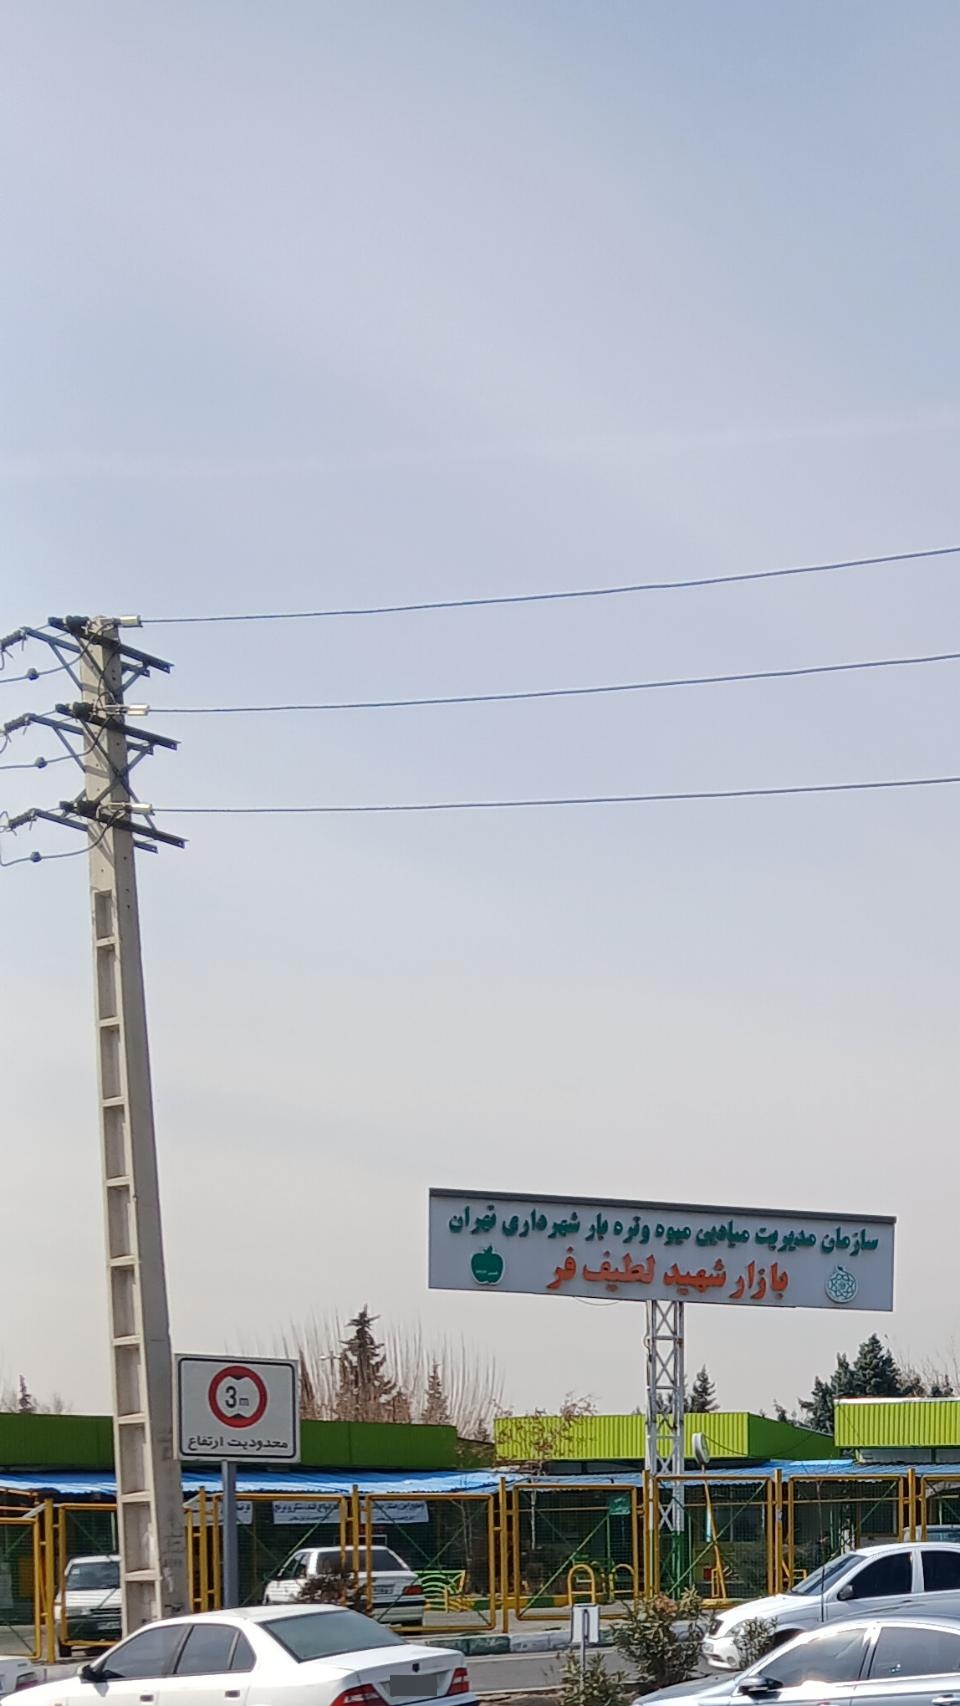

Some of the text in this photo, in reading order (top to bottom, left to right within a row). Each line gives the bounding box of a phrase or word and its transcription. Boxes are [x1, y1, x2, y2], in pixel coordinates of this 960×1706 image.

[448, 1204, 498, 1235] تهران
[502, 1207, 581, 1238] شهرداری
[585, 1211, 609, 1242] بار
[655, 1221, 692, 1246] میوه
[695, 1219, 750, 1249] میادین
[754, 1226, 817, 1254] مدیریت
[820, 1225, 880, 1257] سازمان
[545, 1245, 789, 1300] بازار شهید لطیف فر
[225, 1385, 237, 1408] 3
[187, 1435, 288, 1451] محدودیت ارتفاع
